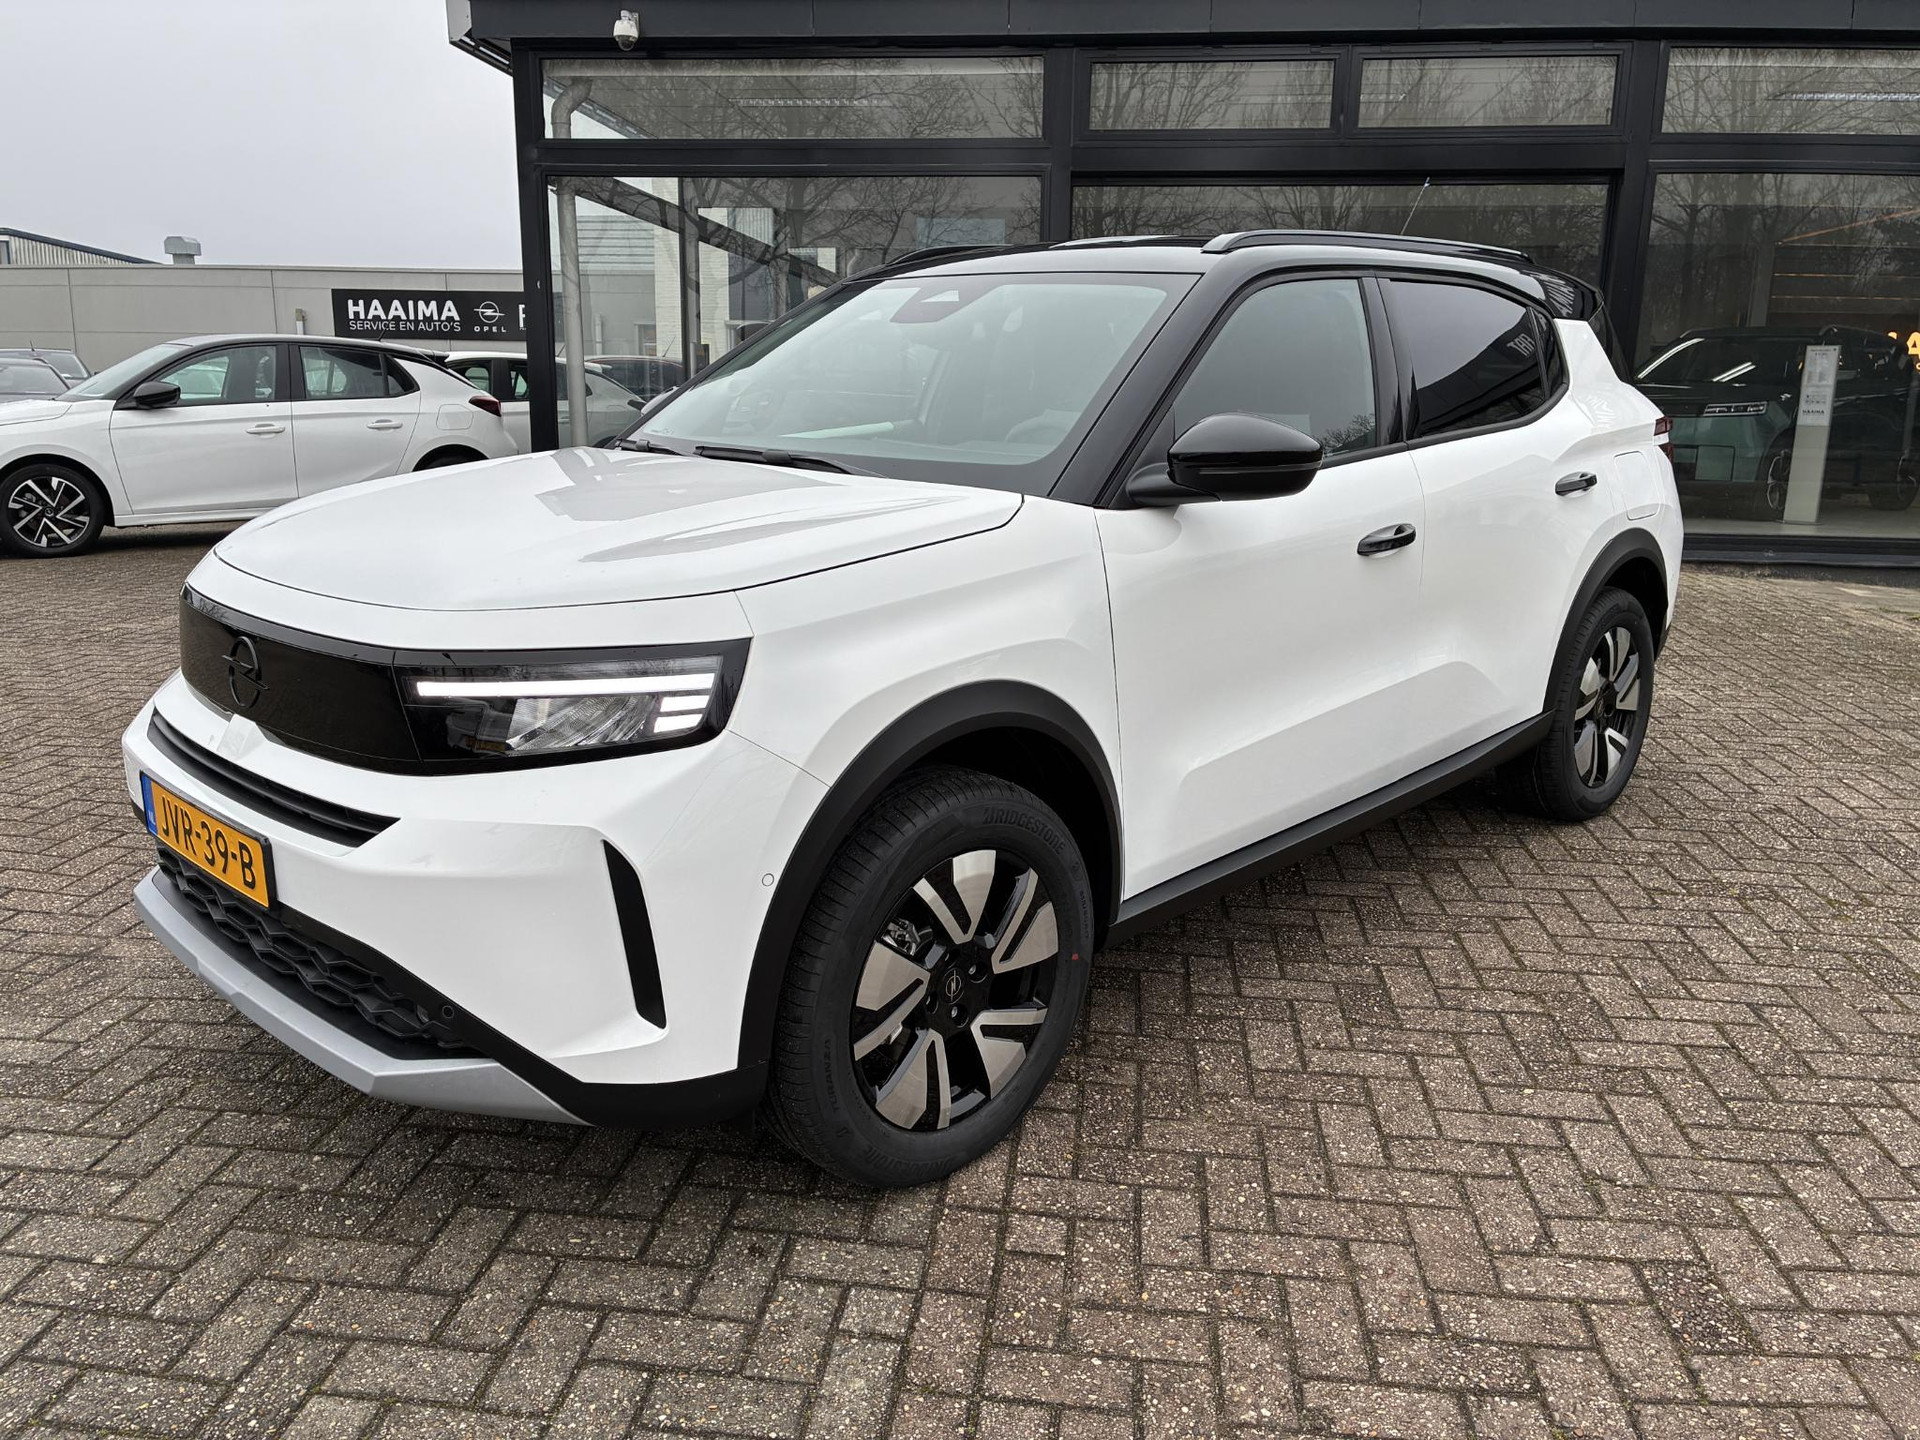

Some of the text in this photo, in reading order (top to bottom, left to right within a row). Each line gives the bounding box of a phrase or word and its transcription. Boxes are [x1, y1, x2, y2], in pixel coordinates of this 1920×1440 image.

[347, 299, 461, 321] HAAIMA
[349, 320, 461, 332] SERVICE EN AUTO'S
[161, 795, 256, 890] JVR-39-B
[983, 808, 1066, 855] BRIDGESTONE
